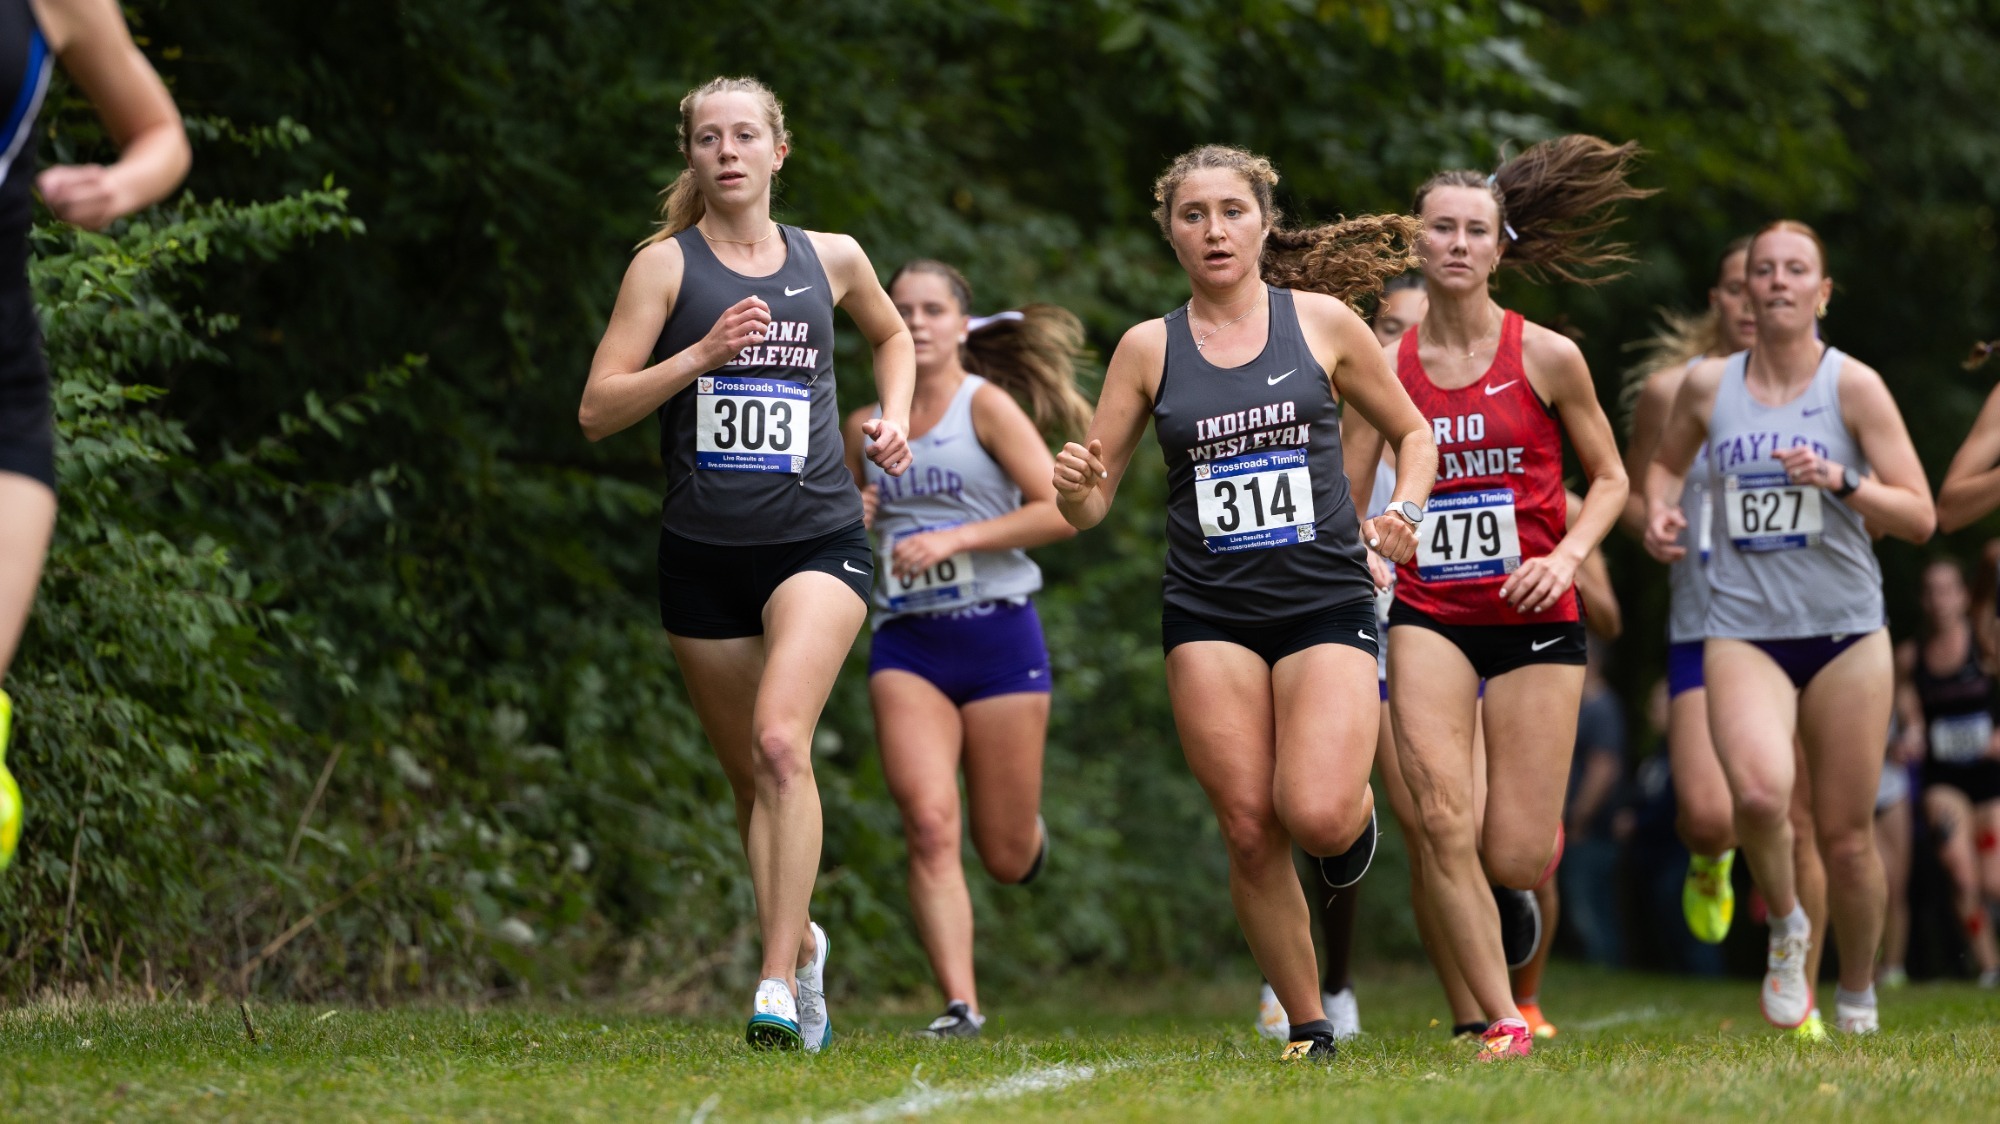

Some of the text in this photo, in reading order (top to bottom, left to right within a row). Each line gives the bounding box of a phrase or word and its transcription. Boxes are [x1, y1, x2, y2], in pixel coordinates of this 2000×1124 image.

[715, 382, 809, 398] Crossroads Timing
[713, 398, 792, 452] 303
[1195, 401, 1297, 442] INDIANA
[1432, 413, 1485, 446] RIO
[1187, 423, 1311, 462] WESLEYAN
[1211, 453, 1306, 475] Crossroads Timing
[1436, 446, 1526, 481] ANDE
[1213, 472, 1297, 532] 314
[1428, 491, 1513, 509] Crossroads Timing
[1740, 490, 1804, 533] 627
[1242, 533, 1264, 541] Results
[1430, 510, 1501, 561] 479
